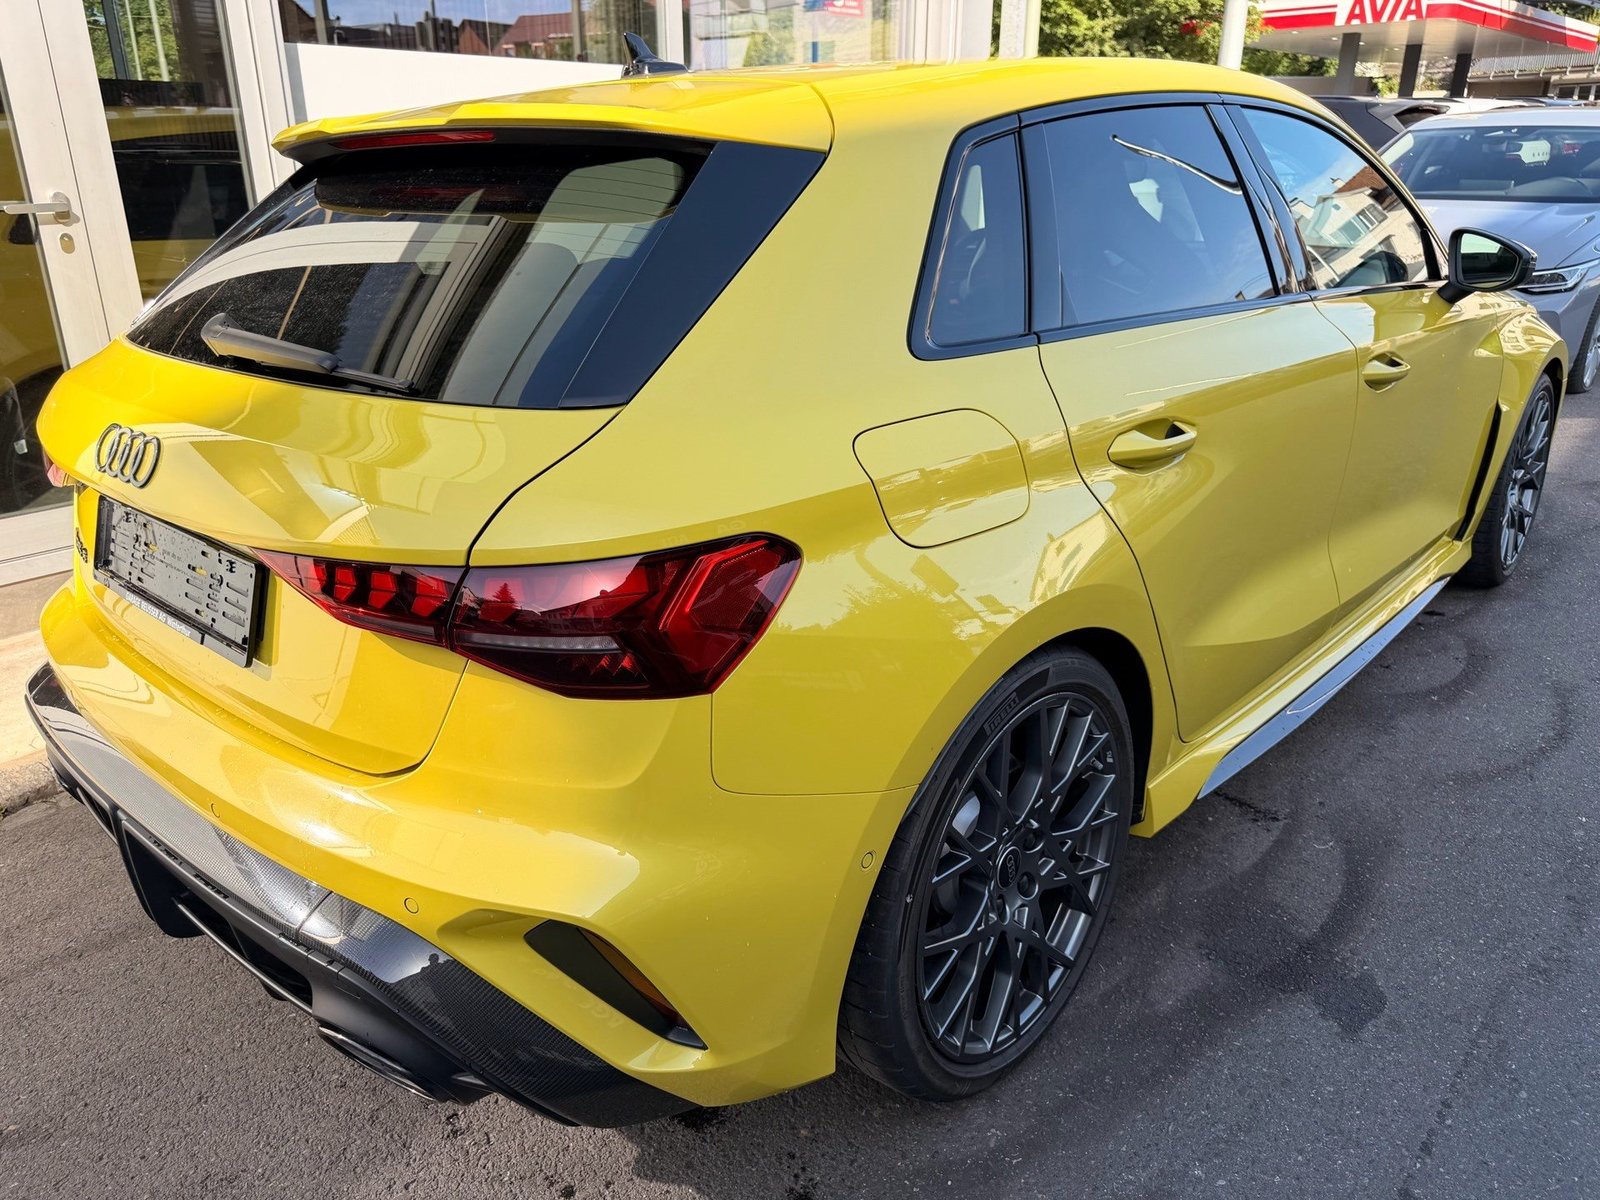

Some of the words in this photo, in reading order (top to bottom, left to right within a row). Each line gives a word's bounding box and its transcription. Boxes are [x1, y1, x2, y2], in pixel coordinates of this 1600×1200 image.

[1345, 0, 1424, 25] AVIA
[159, 610, 167, 623] AG
[167, 616, 191, 637] Winterthur
[983, 691, 1020, 737] PIRELLI
